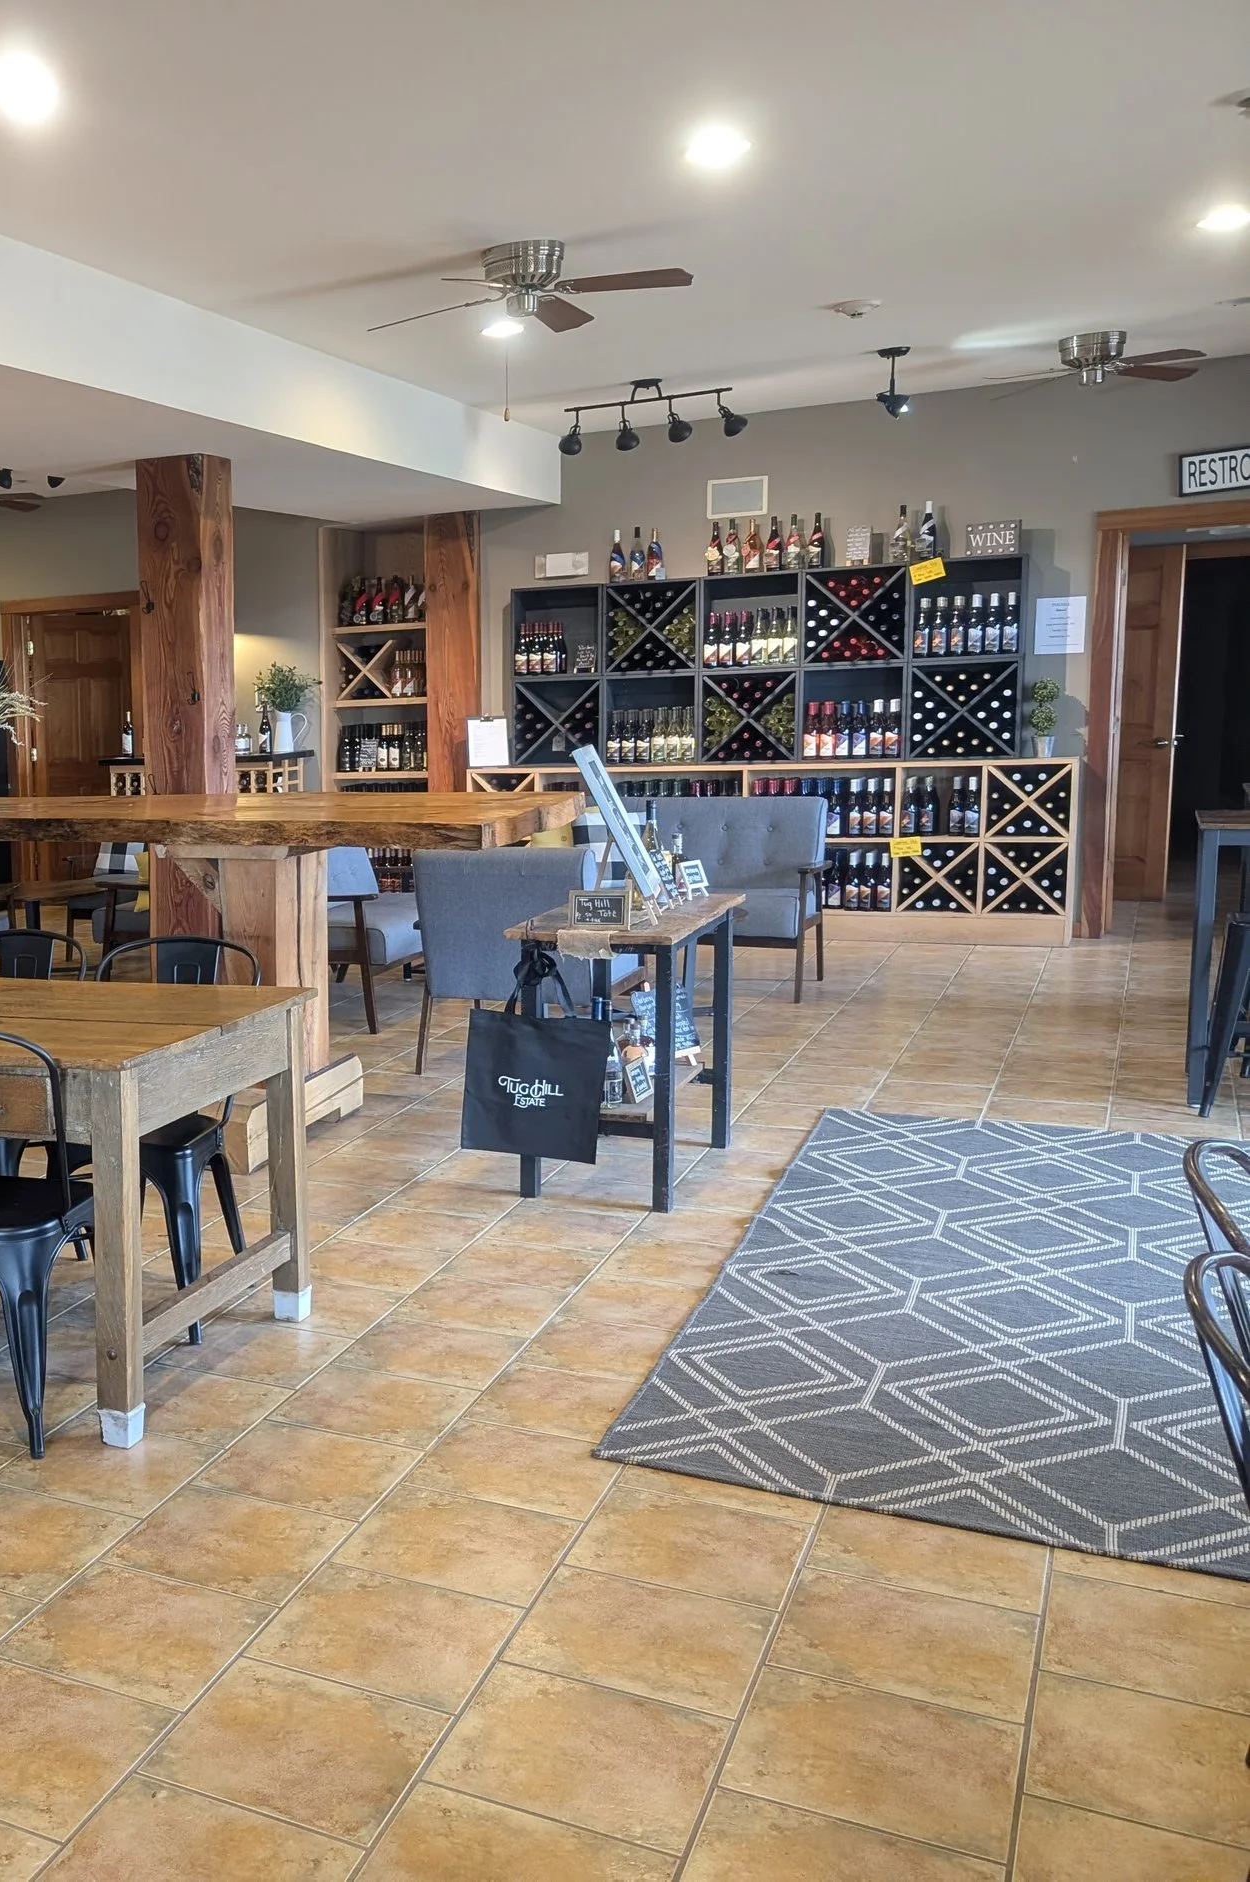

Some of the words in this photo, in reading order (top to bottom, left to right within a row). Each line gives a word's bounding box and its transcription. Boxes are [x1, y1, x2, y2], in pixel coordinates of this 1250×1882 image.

[1188, 453, 1250, 488] RESTRO
[969, 530, 1015, 547] WINE
[579, 898, 593, 911] Tug
[595, 898, 610, 908] Hill
[597, 909, 617, 918] Tote
[498, 1075, 530, 1095] TUG
[530, 1079, 564, 1098] HILL
[513, 1094, 546, 1108] ESTATE
